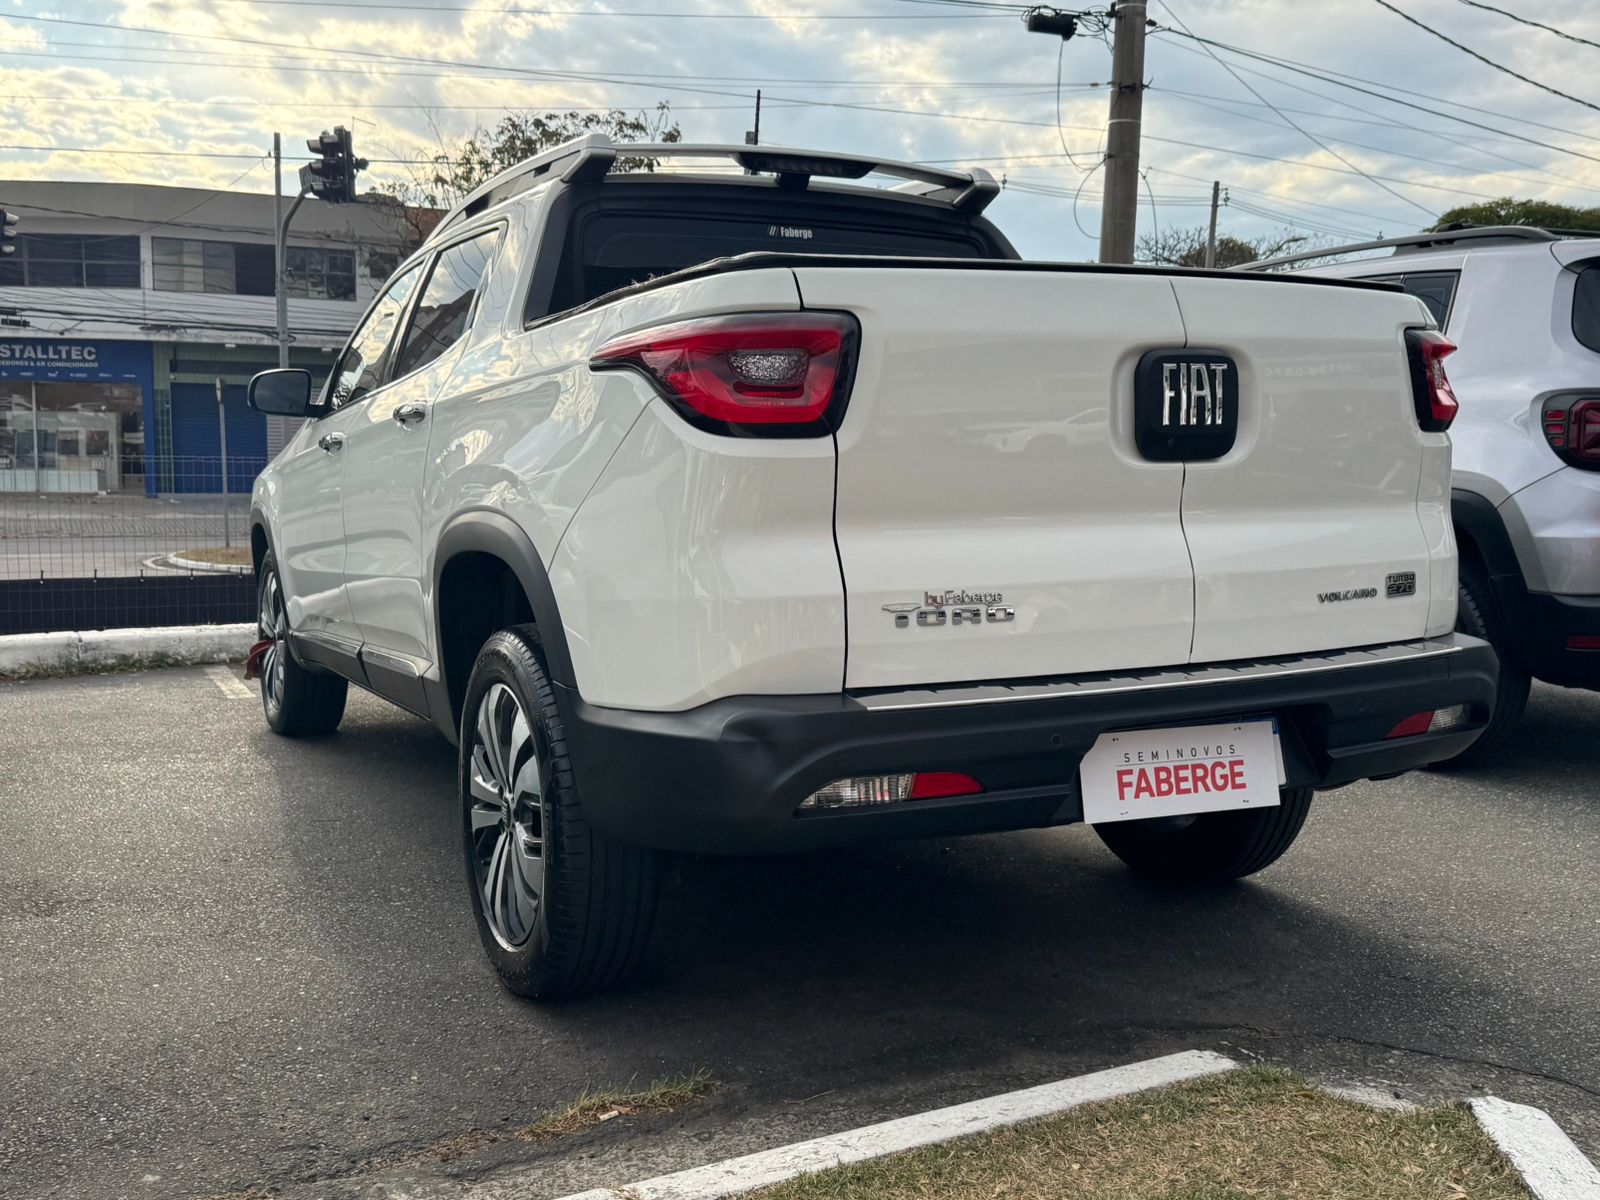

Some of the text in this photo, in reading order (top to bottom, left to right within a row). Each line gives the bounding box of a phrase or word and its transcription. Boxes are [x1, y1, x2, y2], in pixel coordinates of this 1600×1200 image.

[0, 344, 97, 360] STALLTEC
[1162, 363, 1228, 426] FIAT
[1387, 573, 1416, 583] TURBO
[1317, 588, 1378, 603] VOLCANO
[1388, 583, 1415, 595] 270
[881, 603, 1015, 628] TORO
[1124, 744, 1236, 763] SEMINOVOS
[1116, 759, 1247, 801] FABERGE
